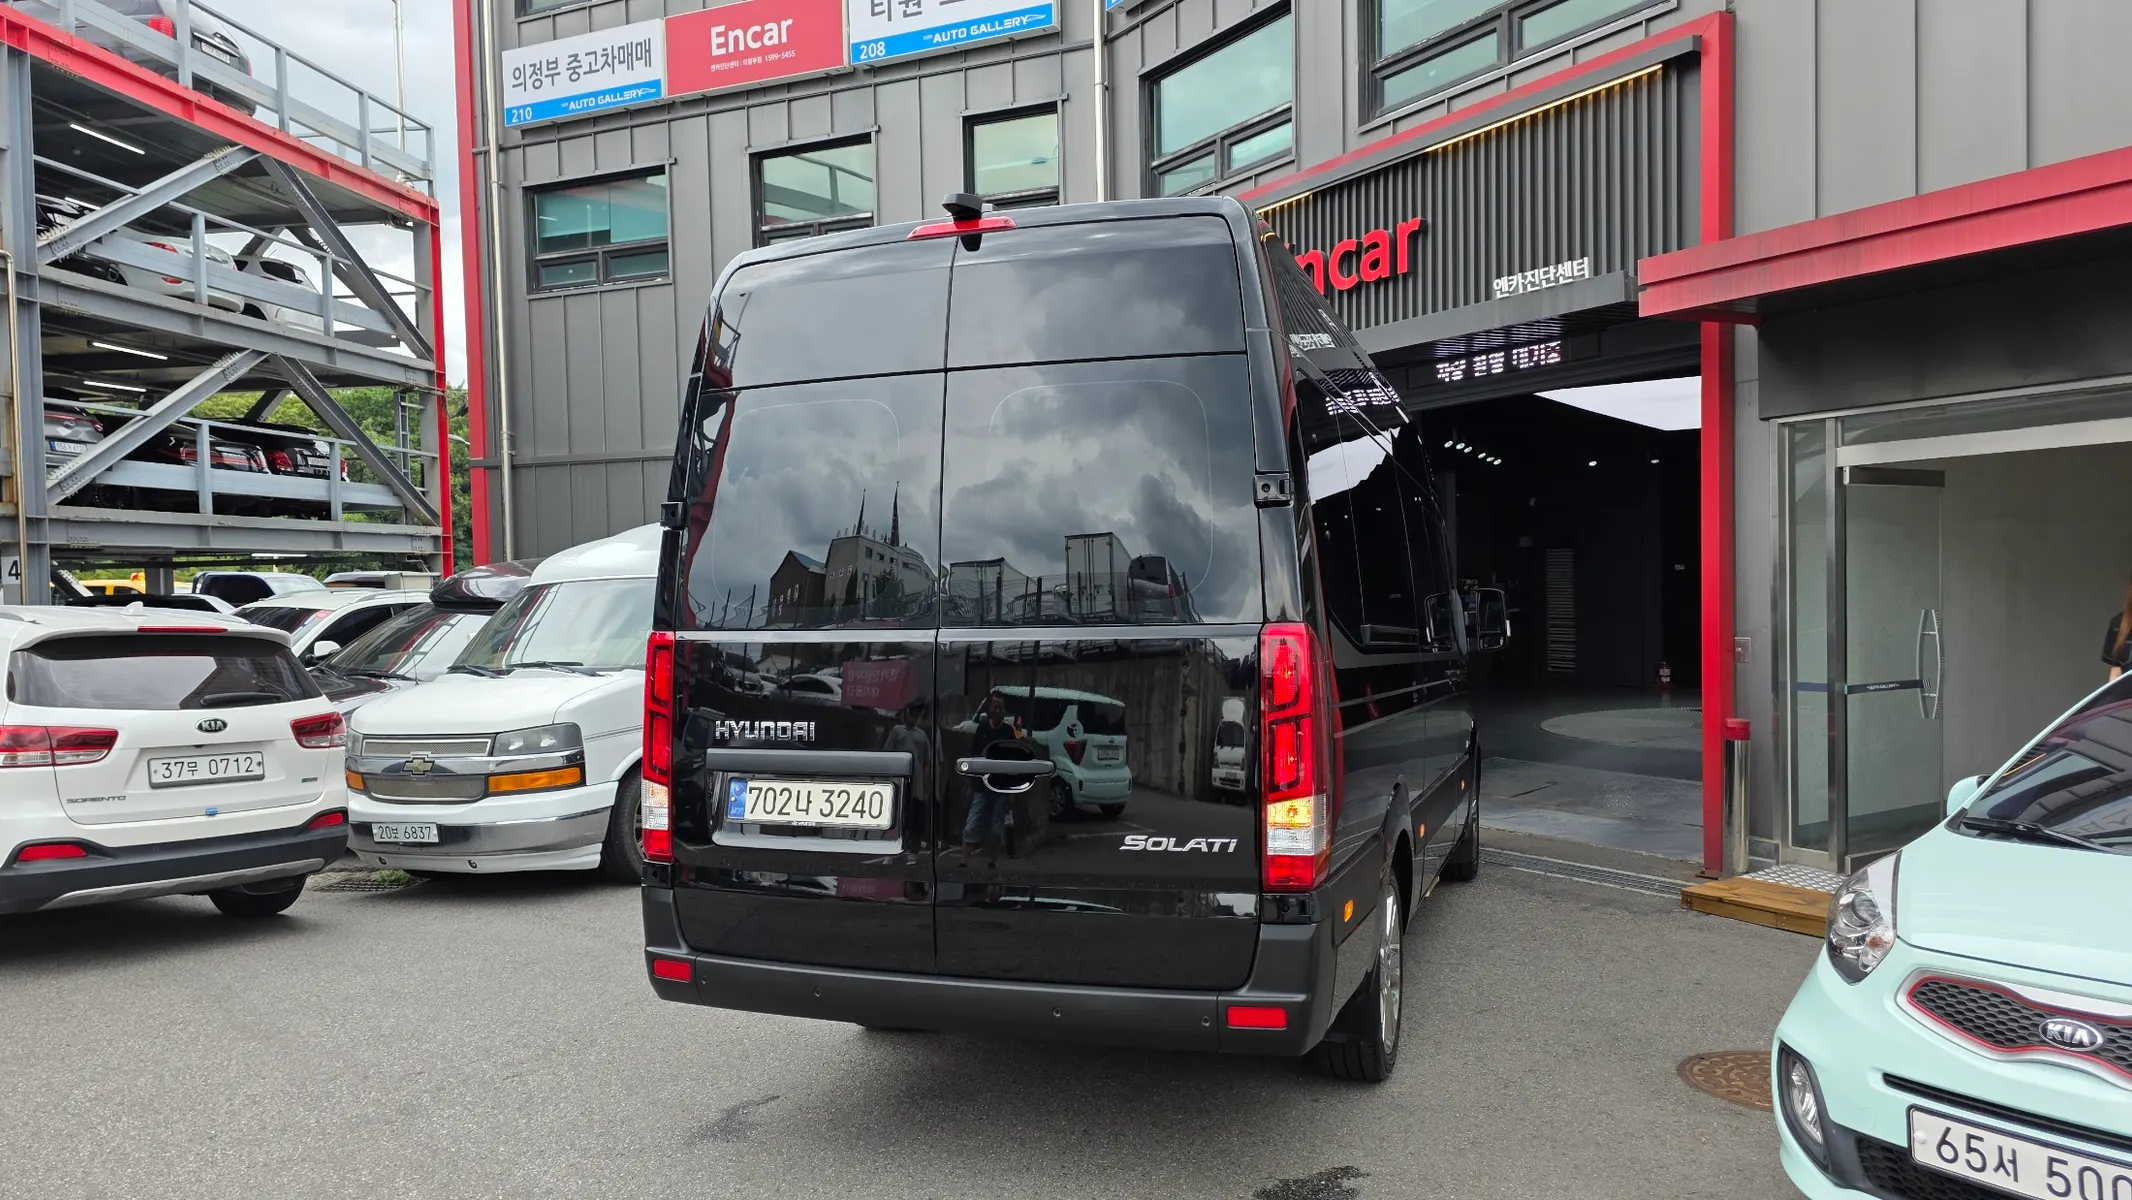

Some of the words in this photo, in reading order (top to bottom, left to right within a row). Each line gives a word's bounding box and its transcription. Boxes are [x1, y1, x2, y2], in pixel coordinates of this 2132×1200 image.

[710, 18, 793, 56] Encar
[933, 28, 967, 43] AUTO
[971, 16, 1028, 36] GALLERY
[860, 41, 886, 60] 208
[512, 57, 561, 92] 의정부
[566, 38, 652, 82] 중고차매매
[569, 97, 596, 110] AUTO
[598, 88, 642, 104] GALLERY
[511, 107, 532, 123] 210
[1285, 217, 1422, 296] ncar
[1493, 256, 1589, 299] 엔카진단센터
[8, 560, 21, 580] 4
[202, 720, 224, 731] KIA
[715, 720, 815, 741] HYUNDAI
[161, 761, 198, 779] 37무
[209, 757, 254, 775] 0712
[66, 795, 126, 804] SORENTO
[749, 786, 812, 816] 702나
[819, 789, 883, 819] 3240
[378, 825, 399, 840] 20보
[404, 826, 431, 840] 6837
[1119, 835, 1238, 853] SOLATI
[2046, 1022, 2091, 1047] KIA
[1935, 1126, 2019, 1183] 65서
